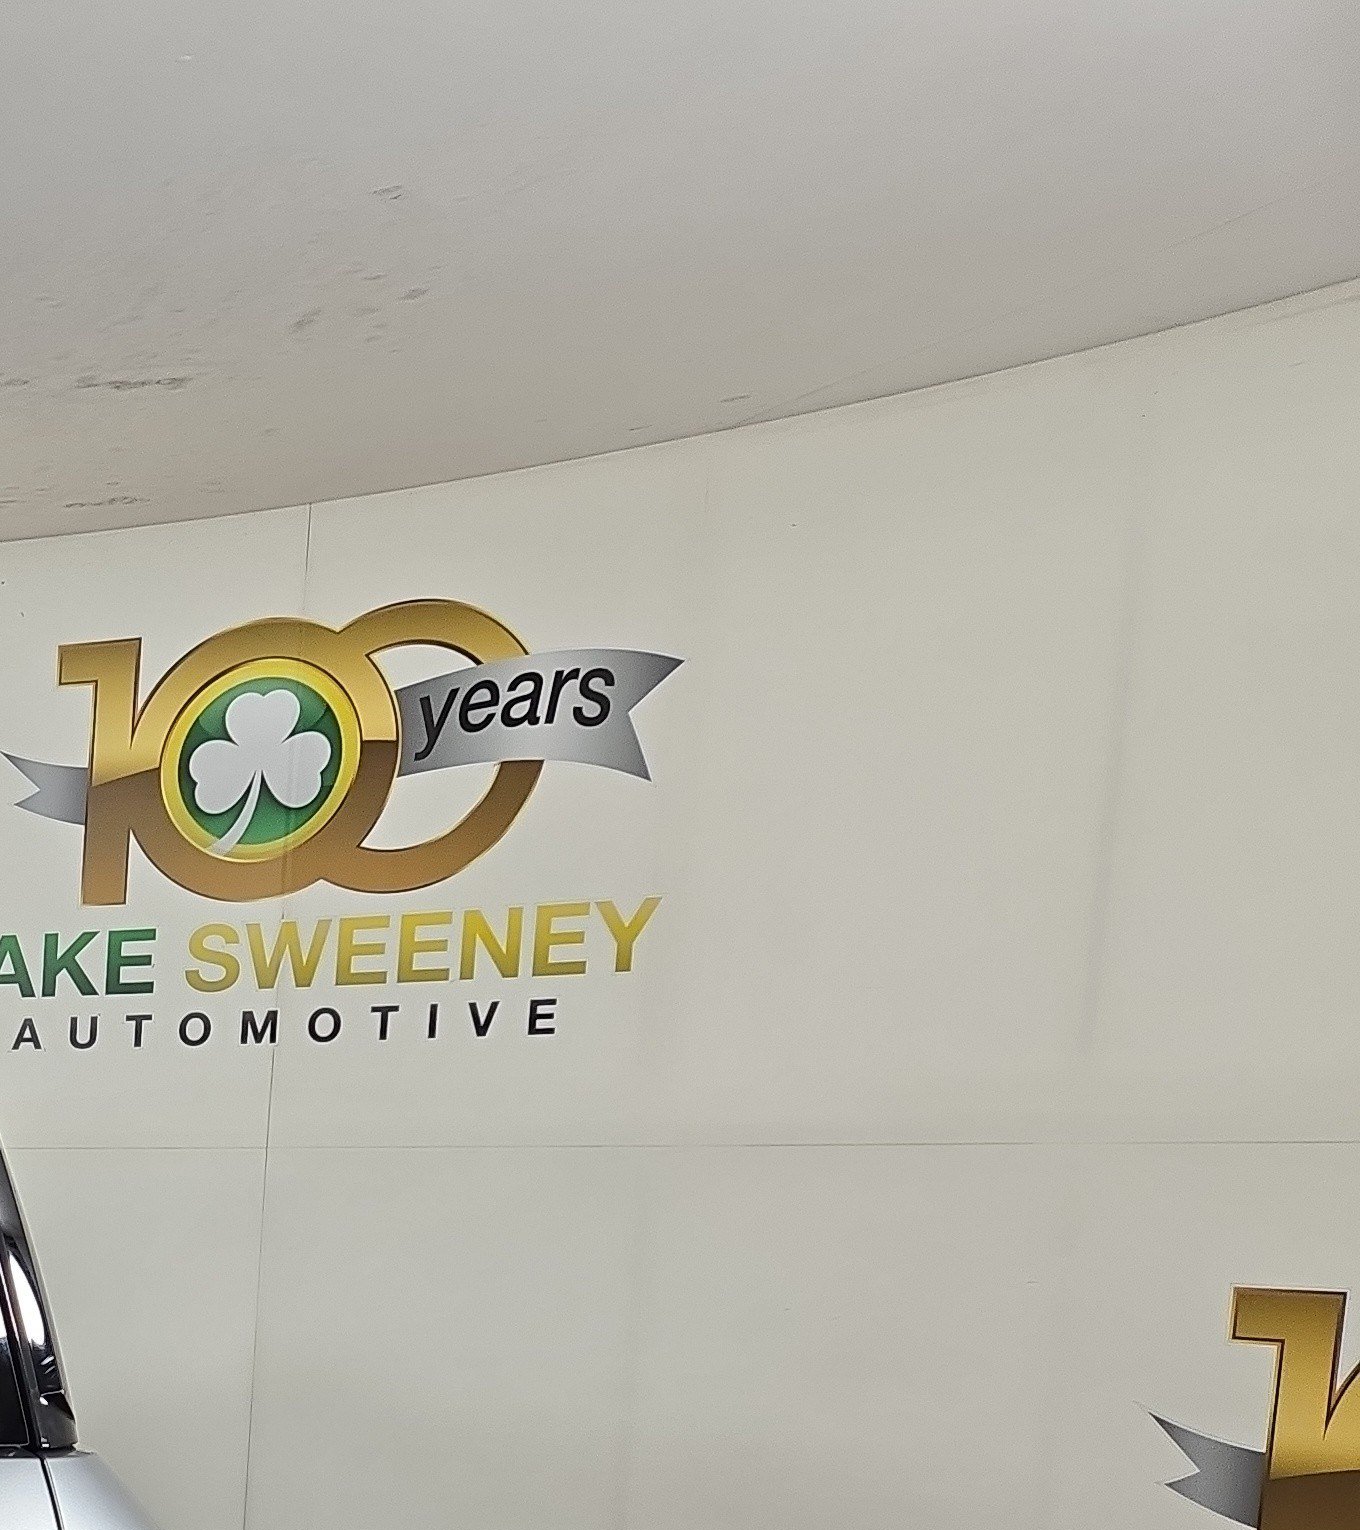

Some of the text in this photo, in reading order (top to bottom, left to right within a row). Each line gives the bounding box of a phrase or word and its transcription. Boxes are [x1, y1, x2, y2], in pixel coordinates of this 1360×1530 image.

[58, 599, 616, 905] 100 years
[184, 897, 662, 994] SWEENEY
[11, 999, 557, 1051] AUTOMOTIVE
